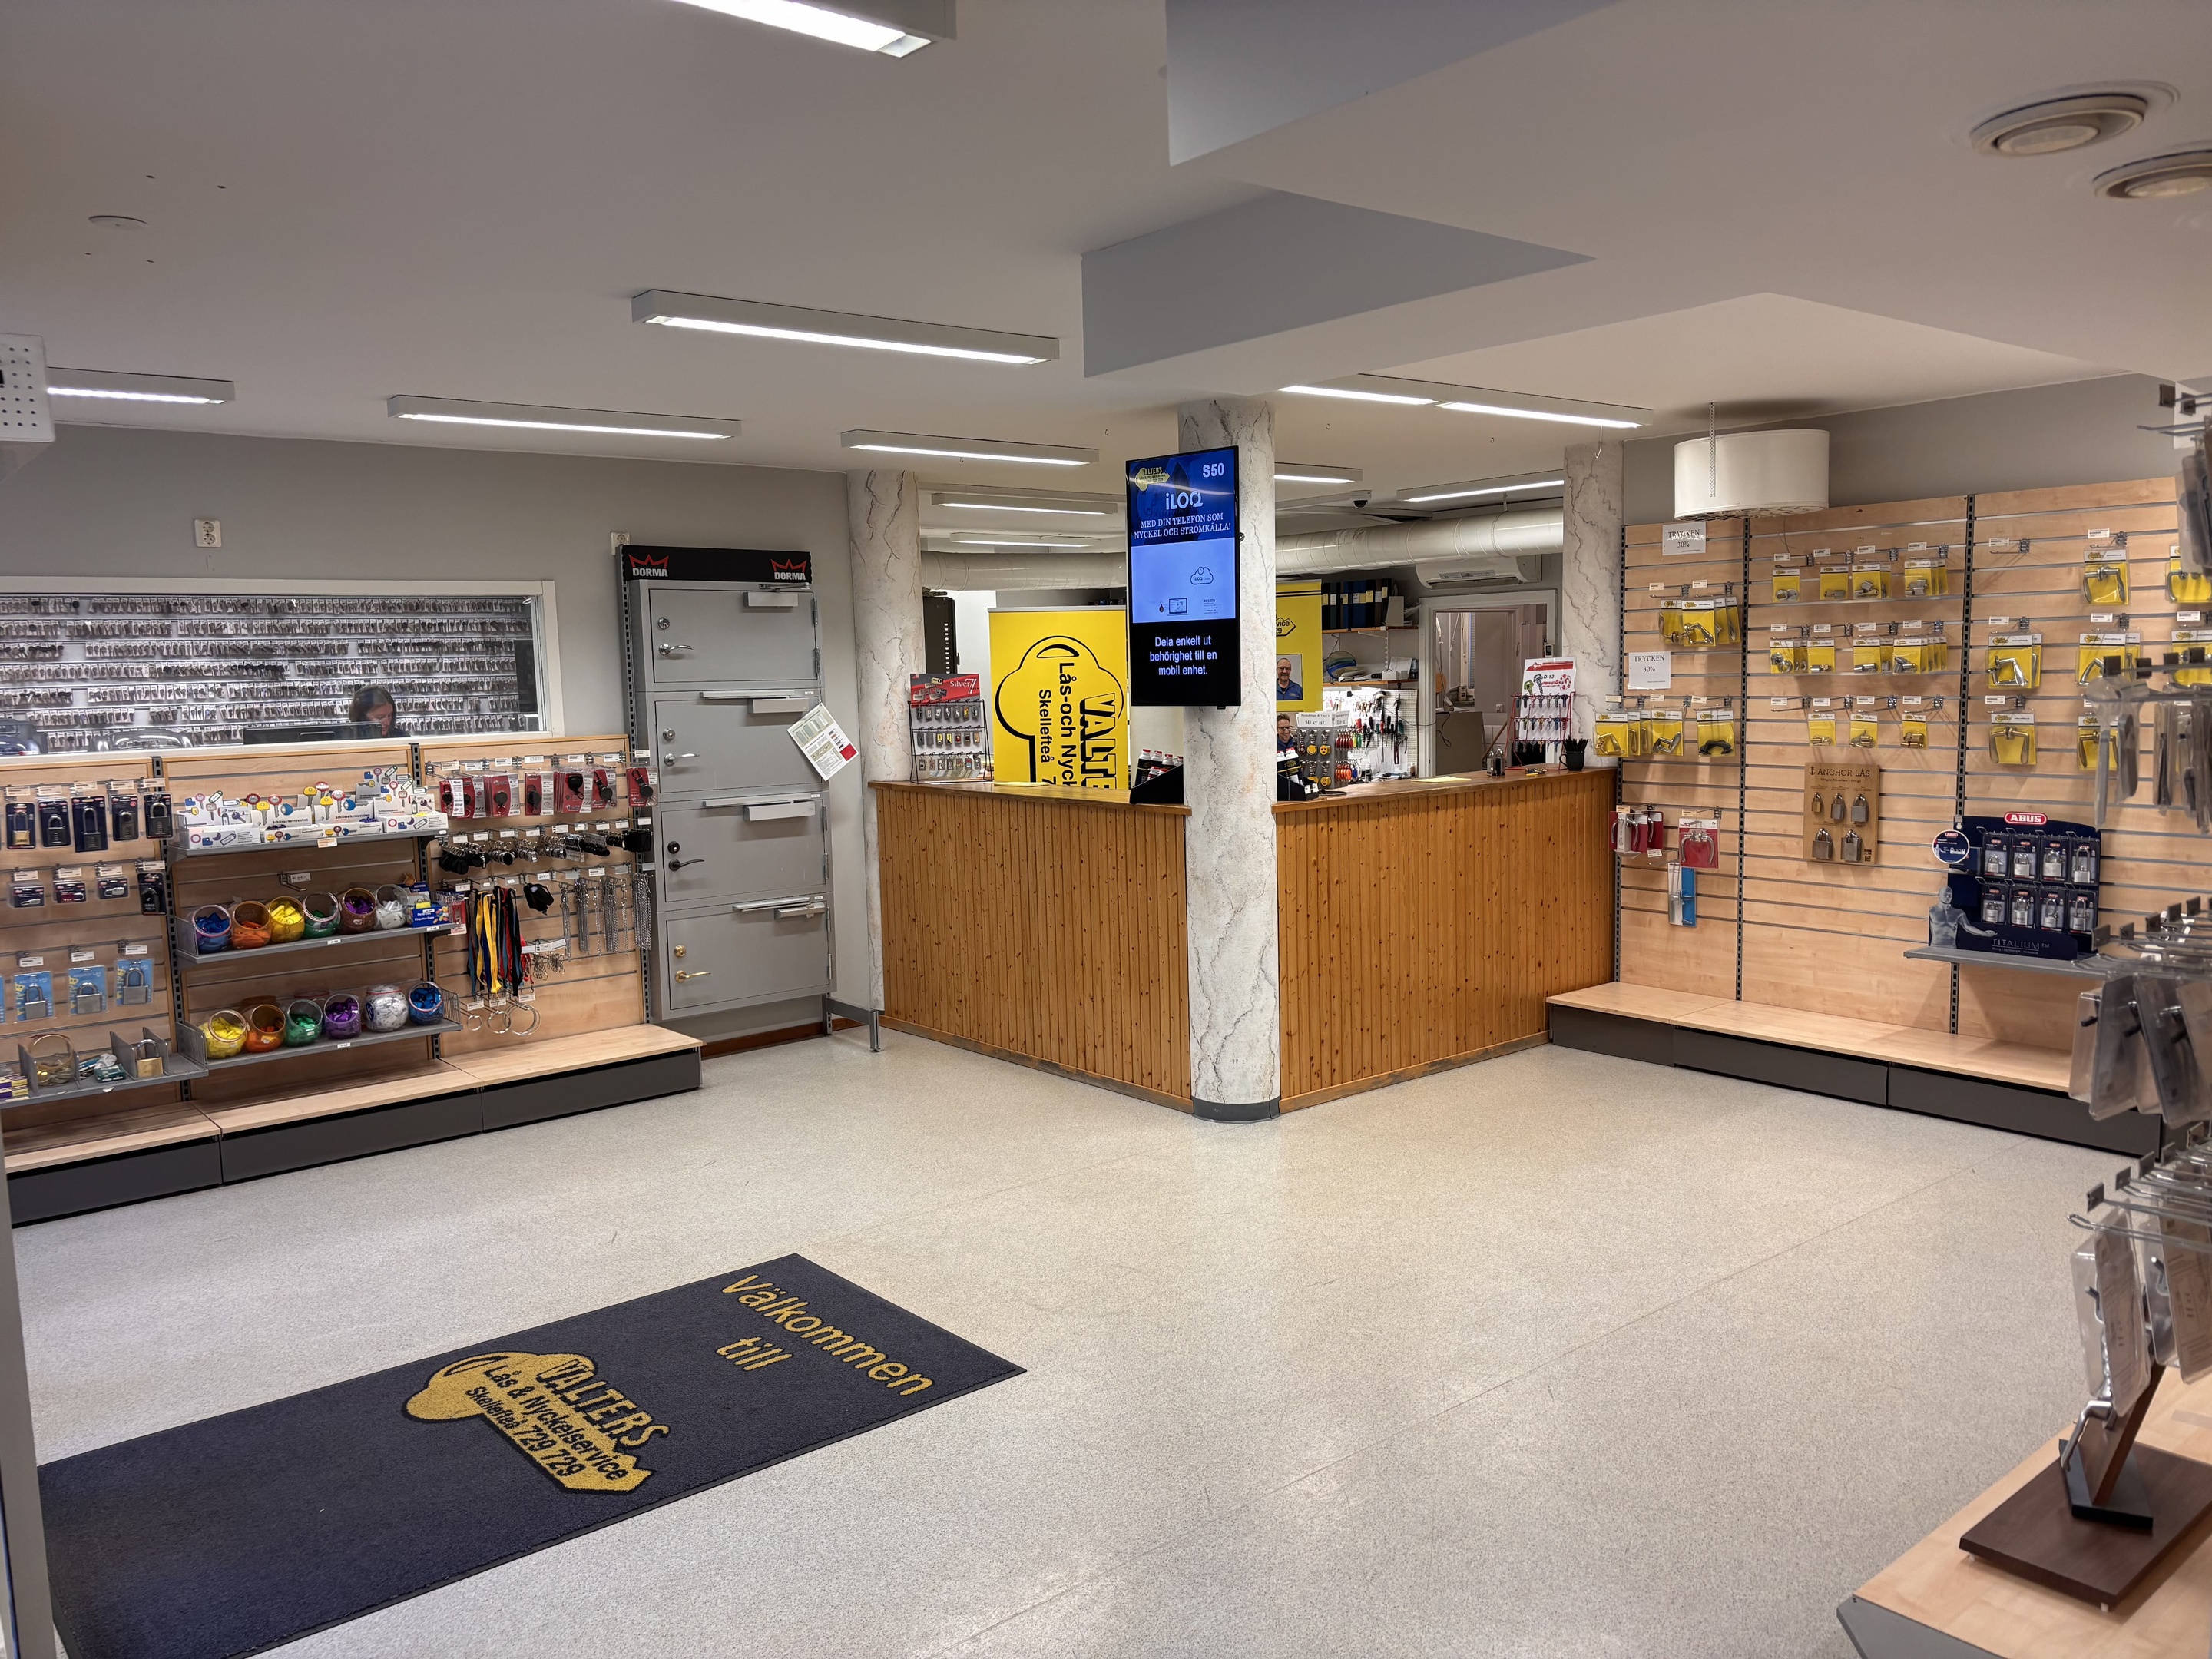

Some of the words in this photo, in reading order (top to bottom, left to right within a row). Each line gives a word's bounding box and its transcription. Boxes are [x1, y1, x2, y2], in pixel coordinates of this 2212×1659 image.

[1203, 462, 1224, 478] S50
[1166, 491, 1203, 510] iLOQ
[1141, 520, 1156, 528] MED
[1157, 518, 1171, 527] DIN
[1172, 515, 1206, 525] TELEFON
[1207, 512, 1224, 522] SOM
[1134, 528, 1162, 539] NYCKEL
[1164, 528, 1178, 536] OCH
[1180, 522, 1231, 535] STRÖMKÄLLA!
[1668, 529, 1700, 538] TRYCKEN
[632, 568, 668, 577] DORMA
[774, 571, 806, 580] DORMA
[1154, 637, 1174, 647] Dela
[1176, 635, 1200, 646] enkelt
[1203, 635, 1211, 645] ut
[1150, 650, 1193, 663] behörighet
[1194, 650, 1204, 661] till
[1207, 651, 1217, 660] en
[1158, 665, 1181, 675] mobil
[1182, 664, 1208, 675] enhet.
[1059, 662, 1077, 737] Lås-och
[1039, 689, 1055, 763] Skellefteå
[1855, 768, 1870, 777] LÅS
[2010, 814, 2041, 823] ABUS
[1992, 939, 2040, 949] TITALIUM
[722, 1275, 933, 1396] Välkommen
[716, 1336, 793, 1371] till
[483, 1365, 522, 1389] Lås
[507, 1386, 535, 1399] &
[536, 1359, 671, 1450] VALTERS
[465, 1386, 528, 1429] Skellefteå
[513, 1425, 558, 1452] 729
[540, 1449, 586, 1477] 729
[519, 1395, 628, 1480] Nyckelservice
